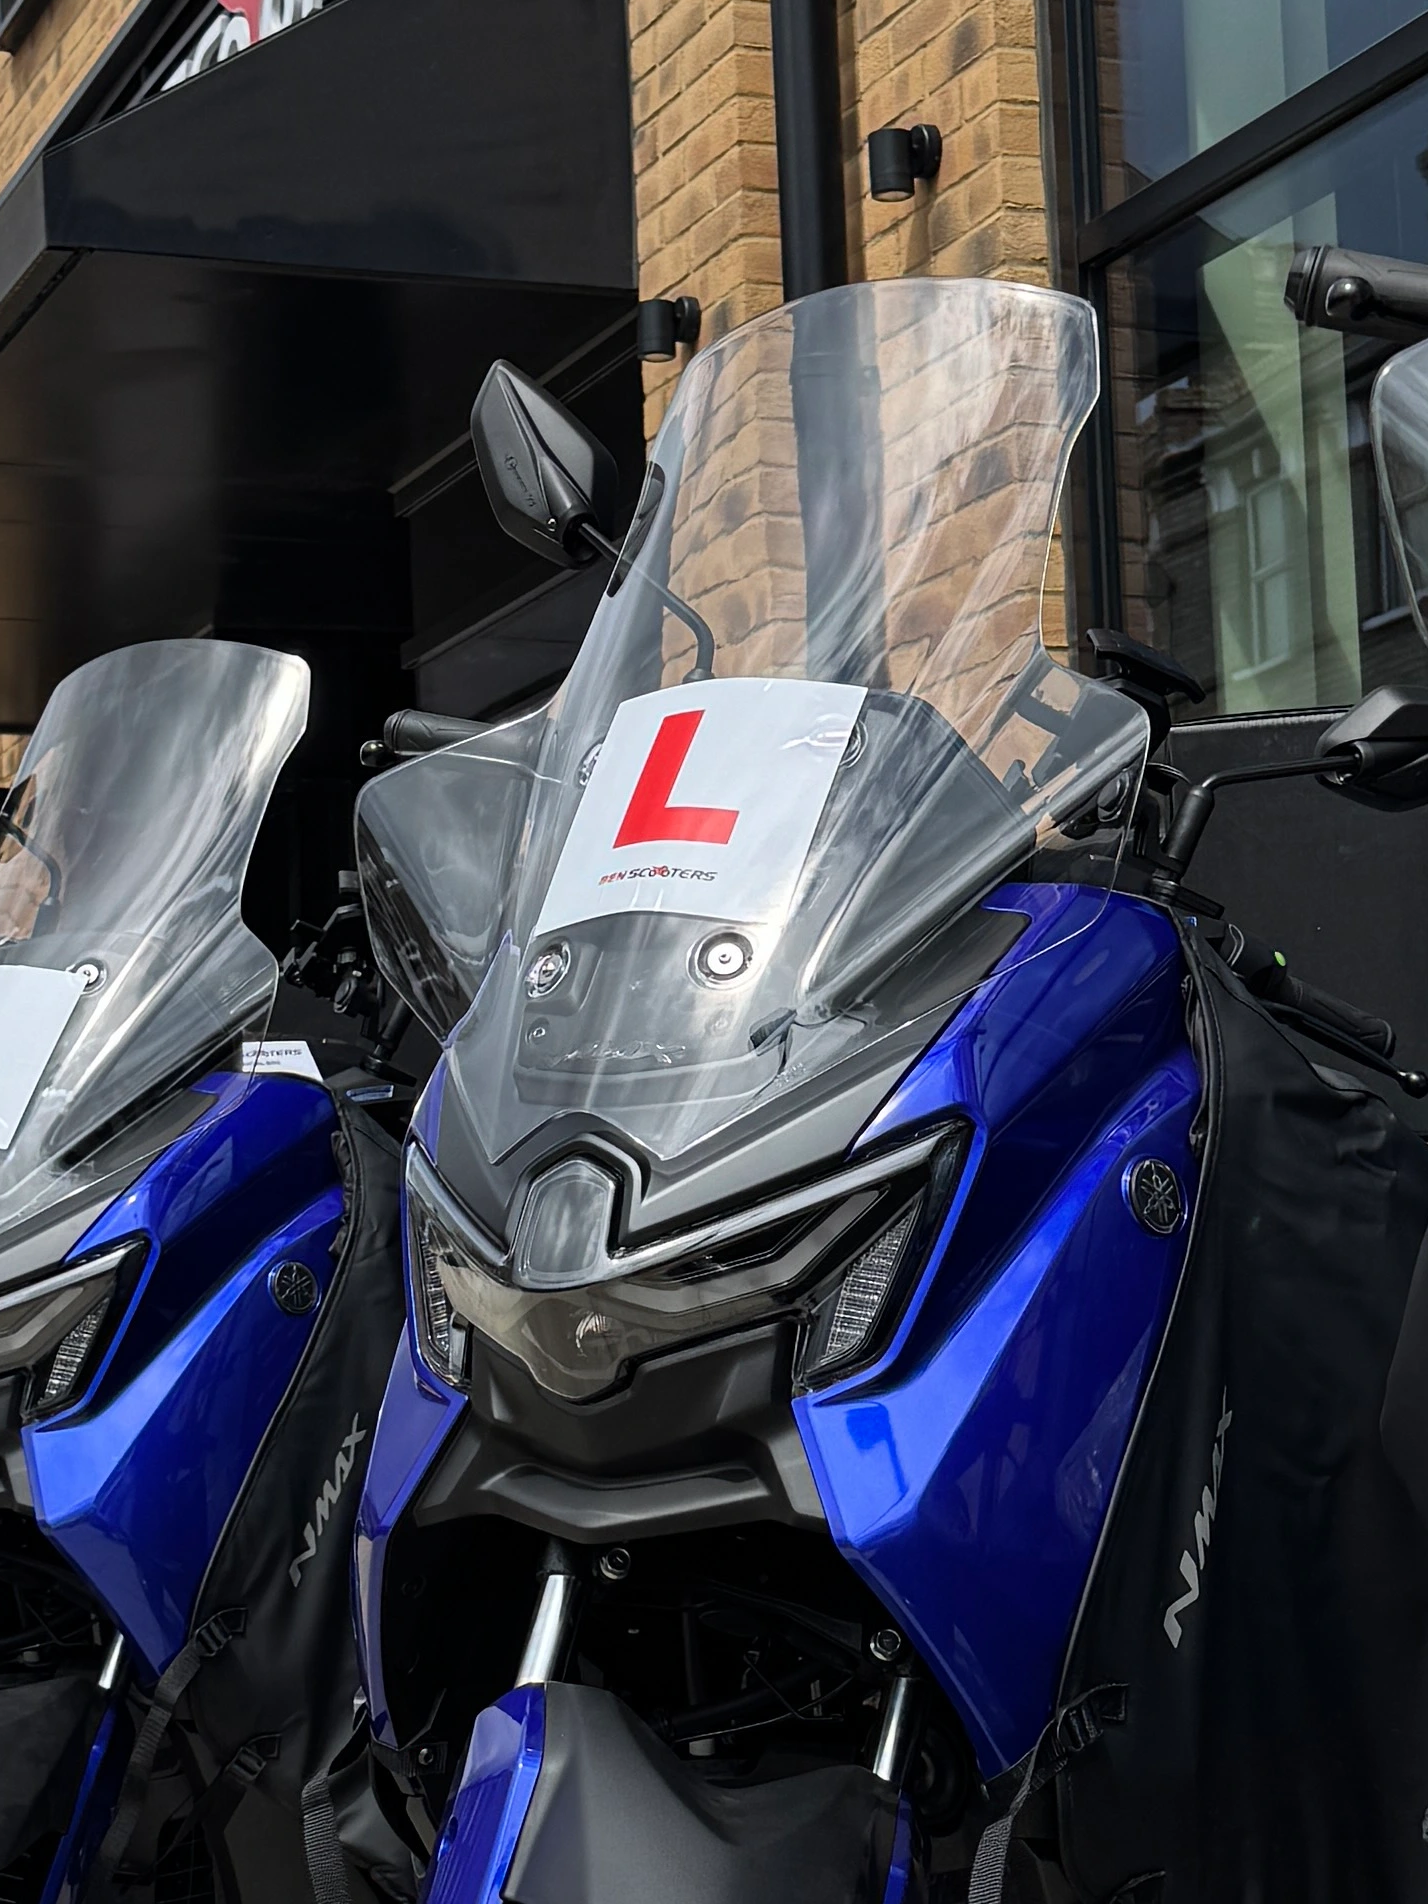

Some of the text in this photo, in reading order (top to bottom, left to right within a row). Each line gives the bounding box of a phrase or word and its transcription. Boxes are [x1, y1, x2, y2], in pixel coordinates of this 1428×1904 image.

[613, 709, 740, 850] L
[598, 865, 718, 886] BEN SCOOTERS
[288, 1411, 368, 1588] NMAX
